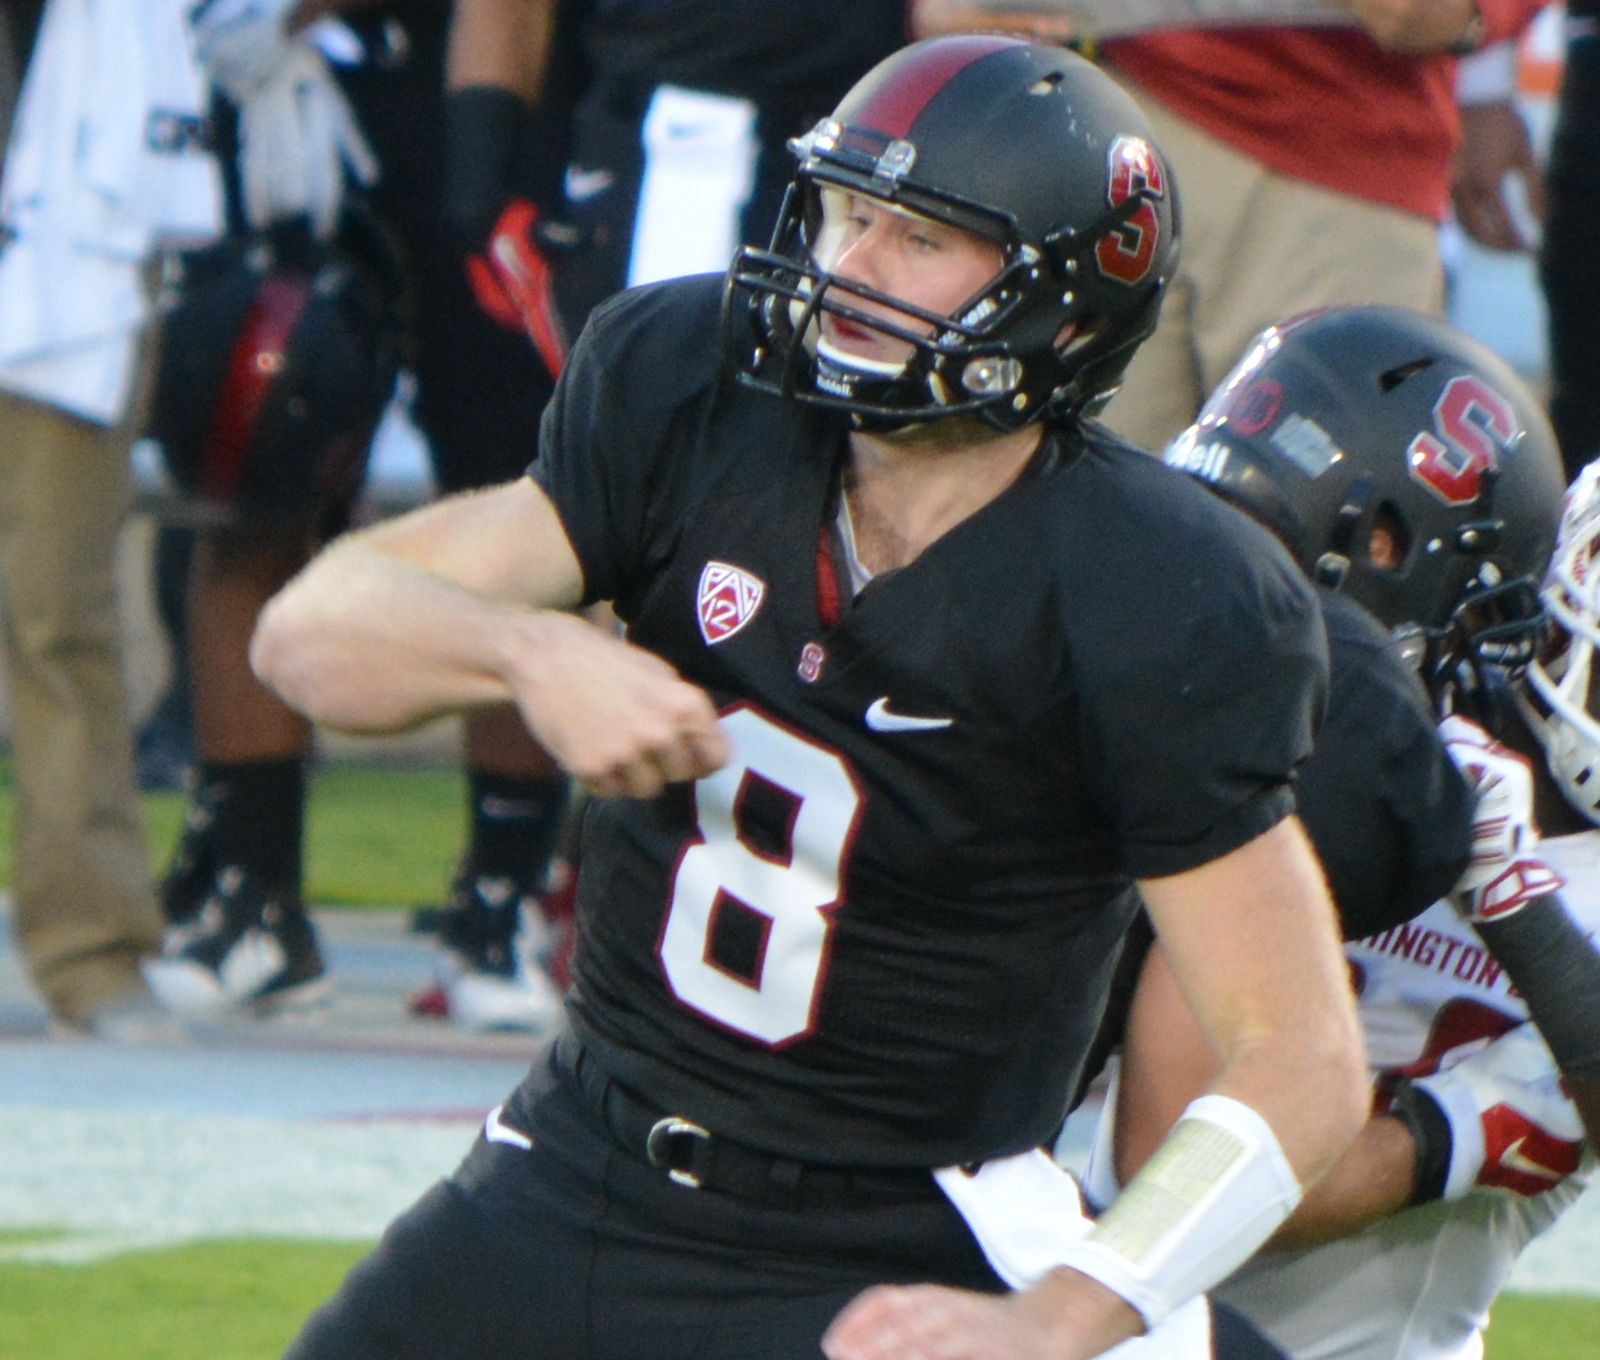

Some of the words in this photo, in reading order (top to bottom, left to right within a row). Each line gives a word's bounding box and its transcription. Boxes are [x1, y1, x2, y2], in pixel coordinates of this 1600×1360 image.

[1096, 133, 1163, 286] S
[1407, 374, 1519, 508] S
[702, 566, 762, 623] PAC
[704, 598, 737, 632] 12
[656, 703, 863, 1047] 8
